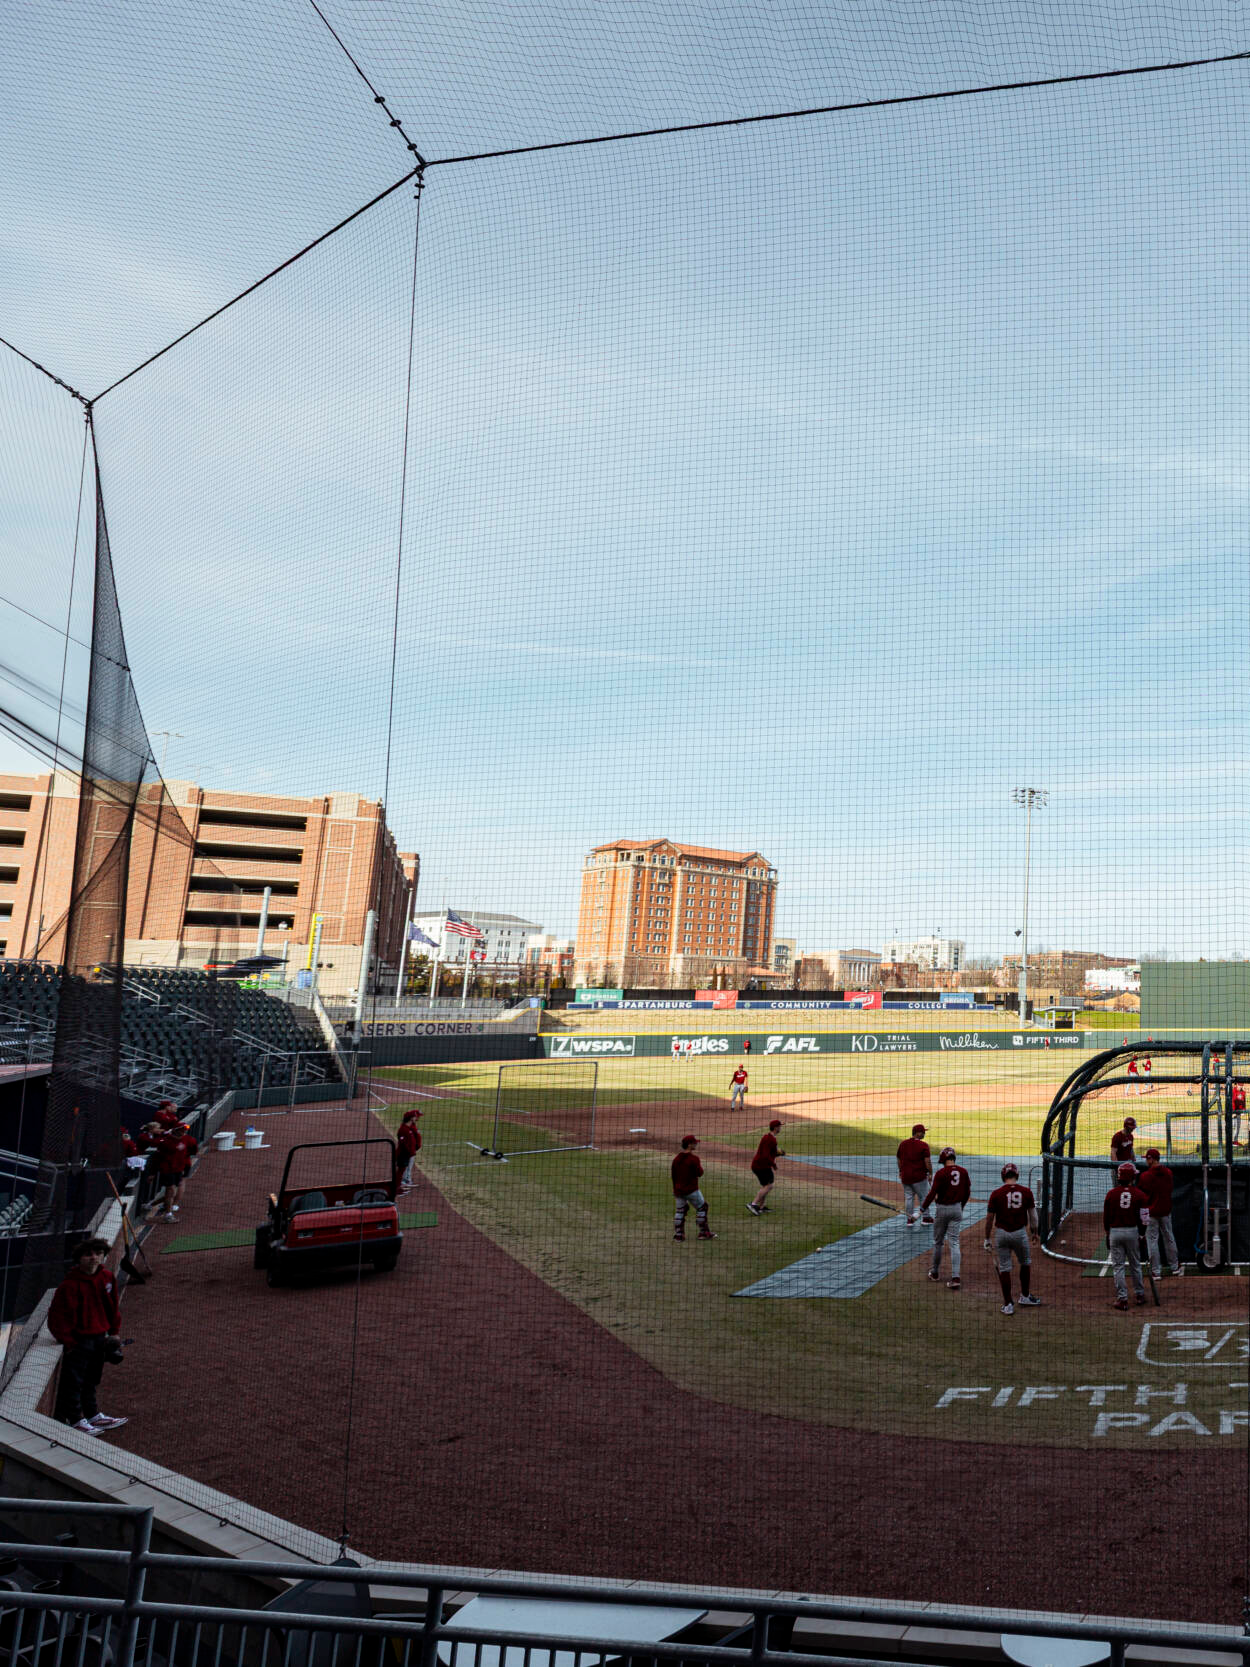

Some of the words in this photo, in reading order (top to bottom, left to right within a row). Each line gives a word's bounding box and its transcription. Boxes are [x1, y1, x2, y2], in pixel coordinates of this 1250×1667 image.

[617, 1001, 692, 1009] SPARTANBURG
[333, 1023, 406, 1037] CSER'S
[415, 1023, 472, 1036] CORNER
[557, 1038, 569, 1051] 7
[573, 1040, 625, 1052] WSPA
[782, 1037, 821, 1052] AFL
[851, 1035, 878, 1052] KD
[1054, 1036, 1079, 1044] THIRD
[950, 1170, 960, 1186] 3
[1006, 1191, 1023, 1209] 19
[1119, 1191, 1132, 1209] 8
[933, 1382, 1188, 1408] FIFTH
